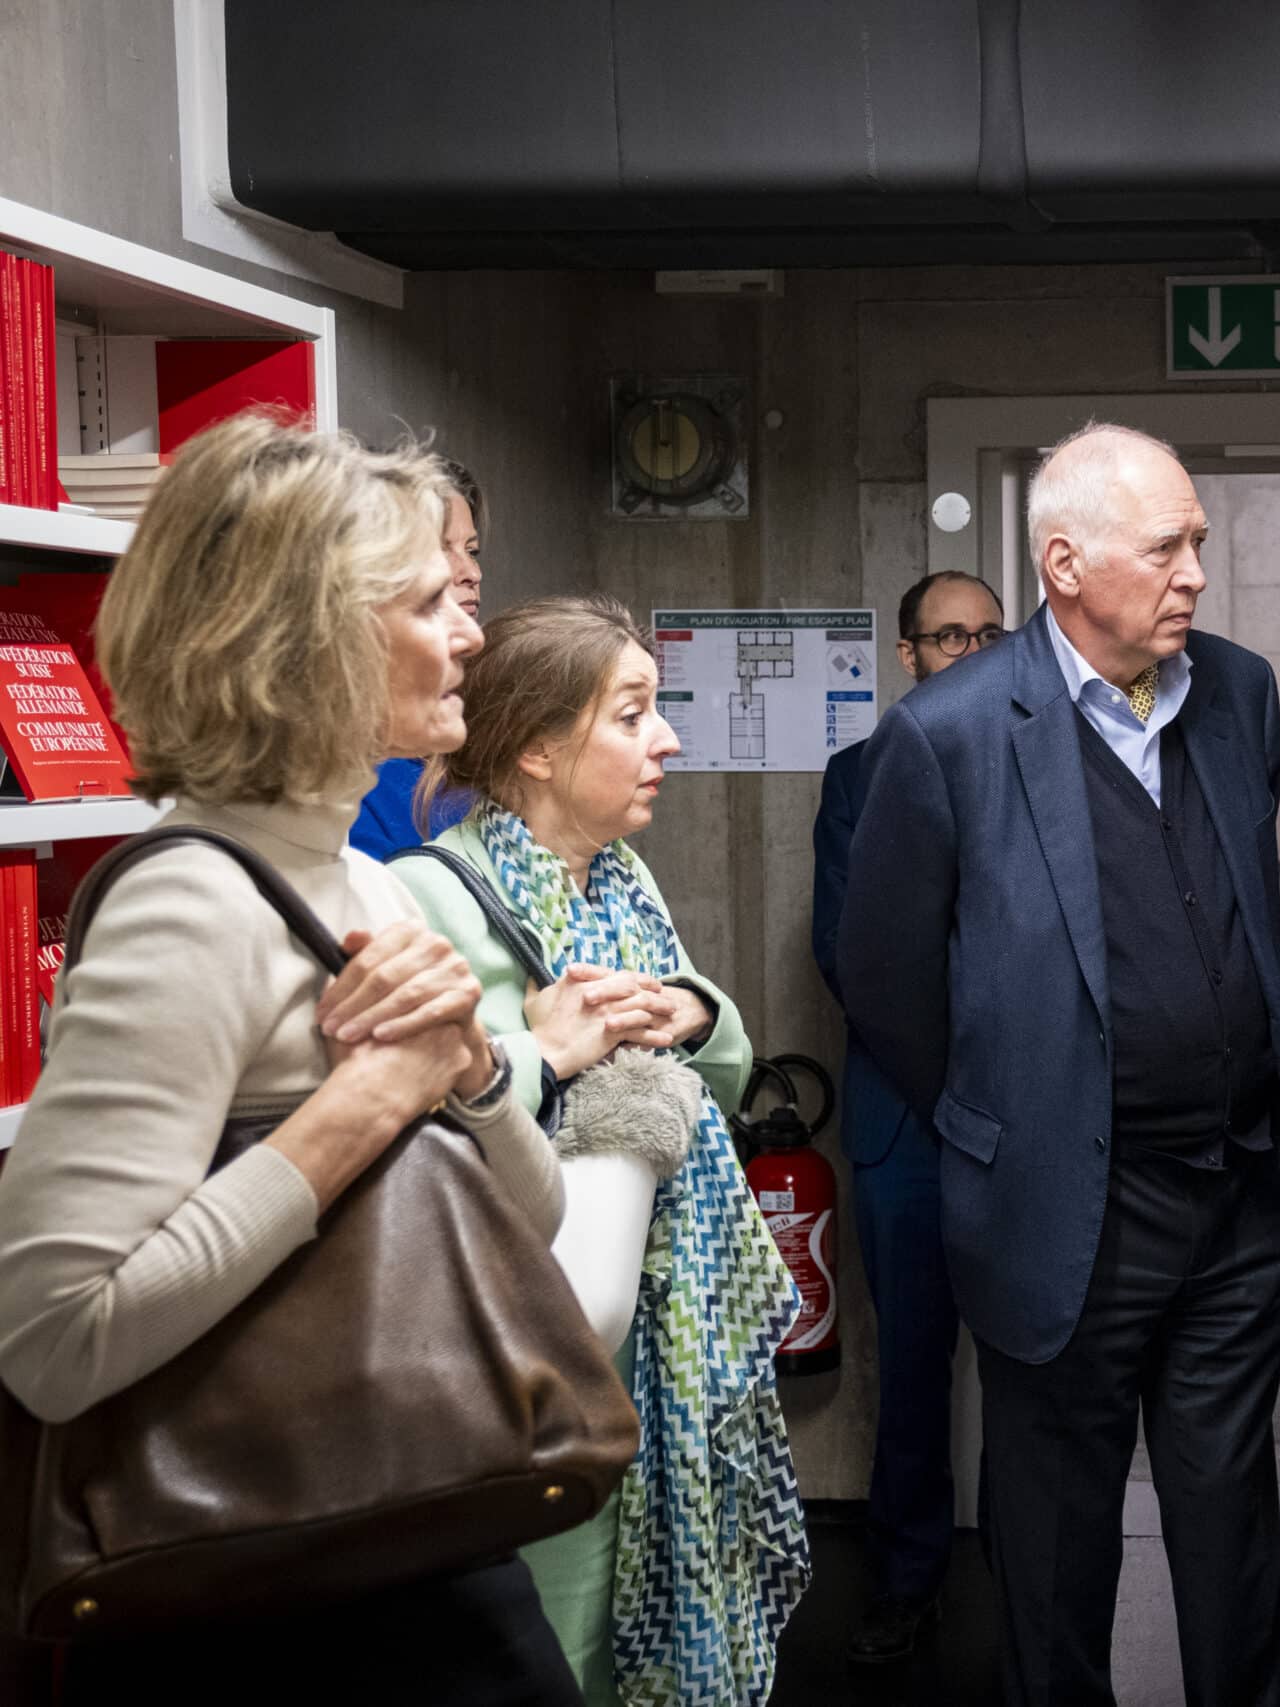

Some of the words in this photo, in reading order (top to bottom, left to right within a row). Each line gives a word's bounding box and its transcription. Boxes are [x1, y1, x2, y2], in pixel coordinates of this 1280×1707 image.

[690, 615, 714, 626] PLAN
[786, 615, 806, 625] FIRE
[807, 615, 844, 626] ESCAPE
[845, 614, 870, 625] PLAN
[15, 663, 54, 678] SUISSE
[6, 683, 82, 701] FÉDÉRATION
[15, 699, 89, 716] ALLEMANDE
[17, 721, 107, 737] COMMUNAUTÉ
[29, 735, 109, 752] EUROPÉENNE
[39, 914, 70, 941] JEA
